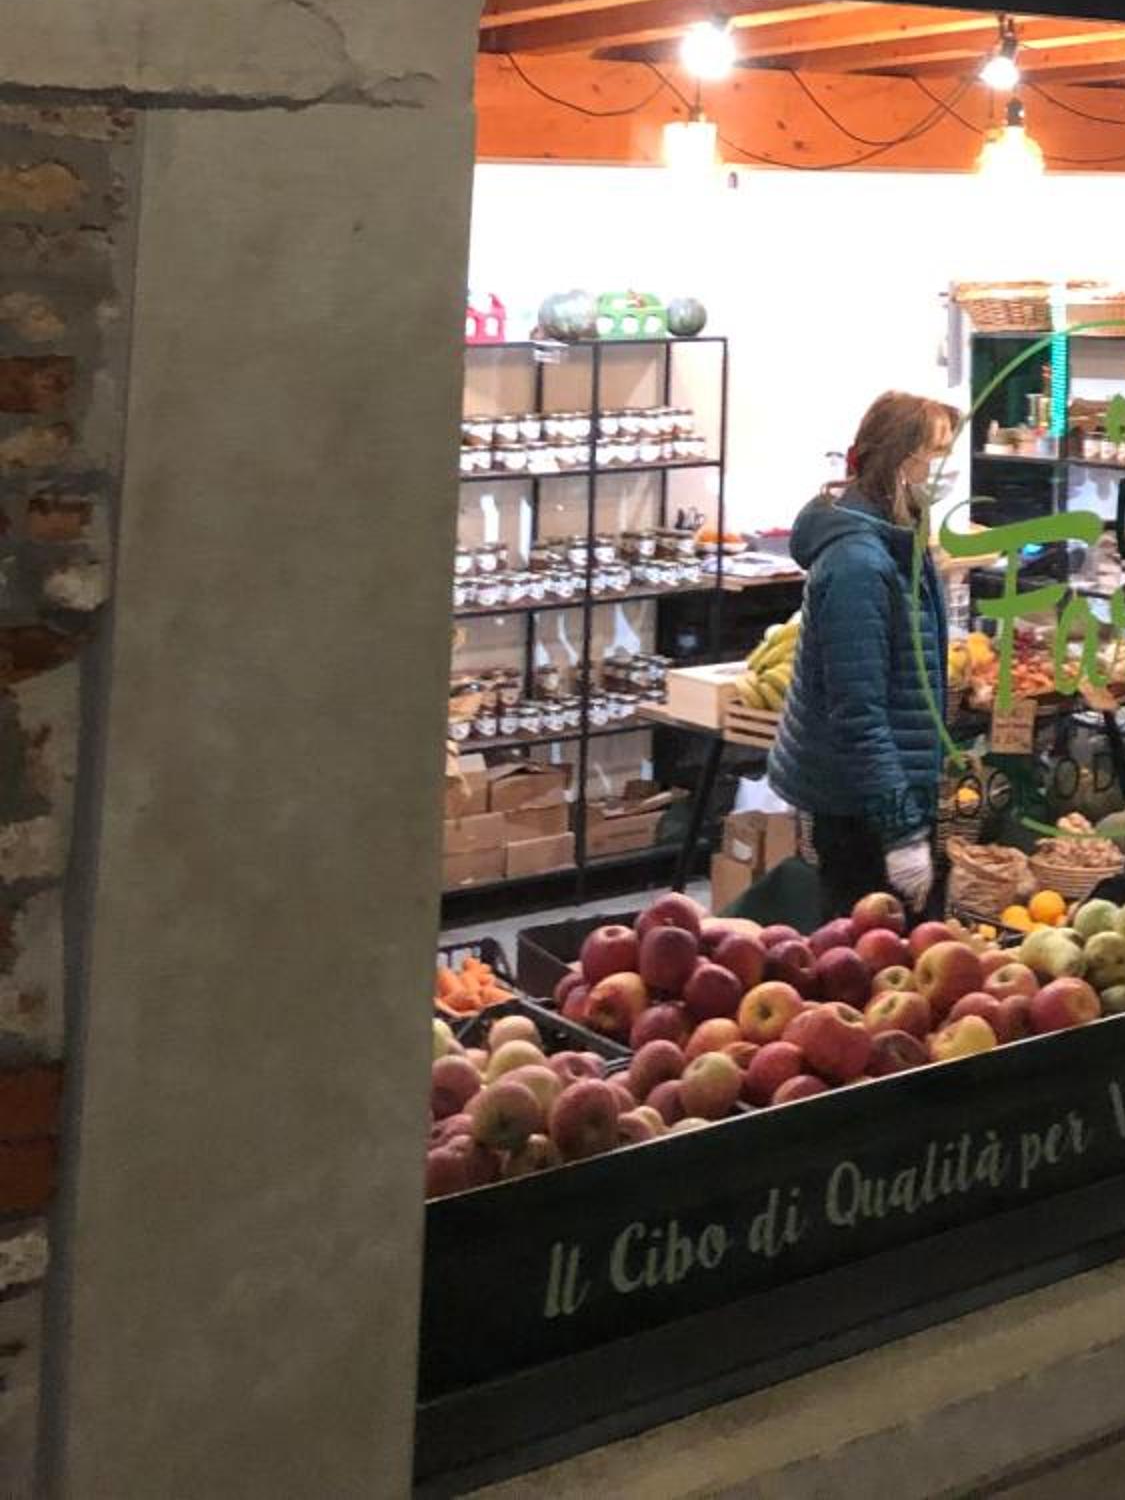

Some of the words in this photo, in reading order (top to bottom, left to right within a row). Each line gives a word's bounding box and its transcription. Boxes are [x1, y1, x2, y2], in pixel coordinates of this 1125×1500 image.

[543, 1241, 591, 1319] Il
[609, 1219, 731, 1295] Cibo
[748, 1186, 803, 1259] di
[825, 1129, 1006, 1226] Qualità
[1020, 1108, 1089, 1188] per
